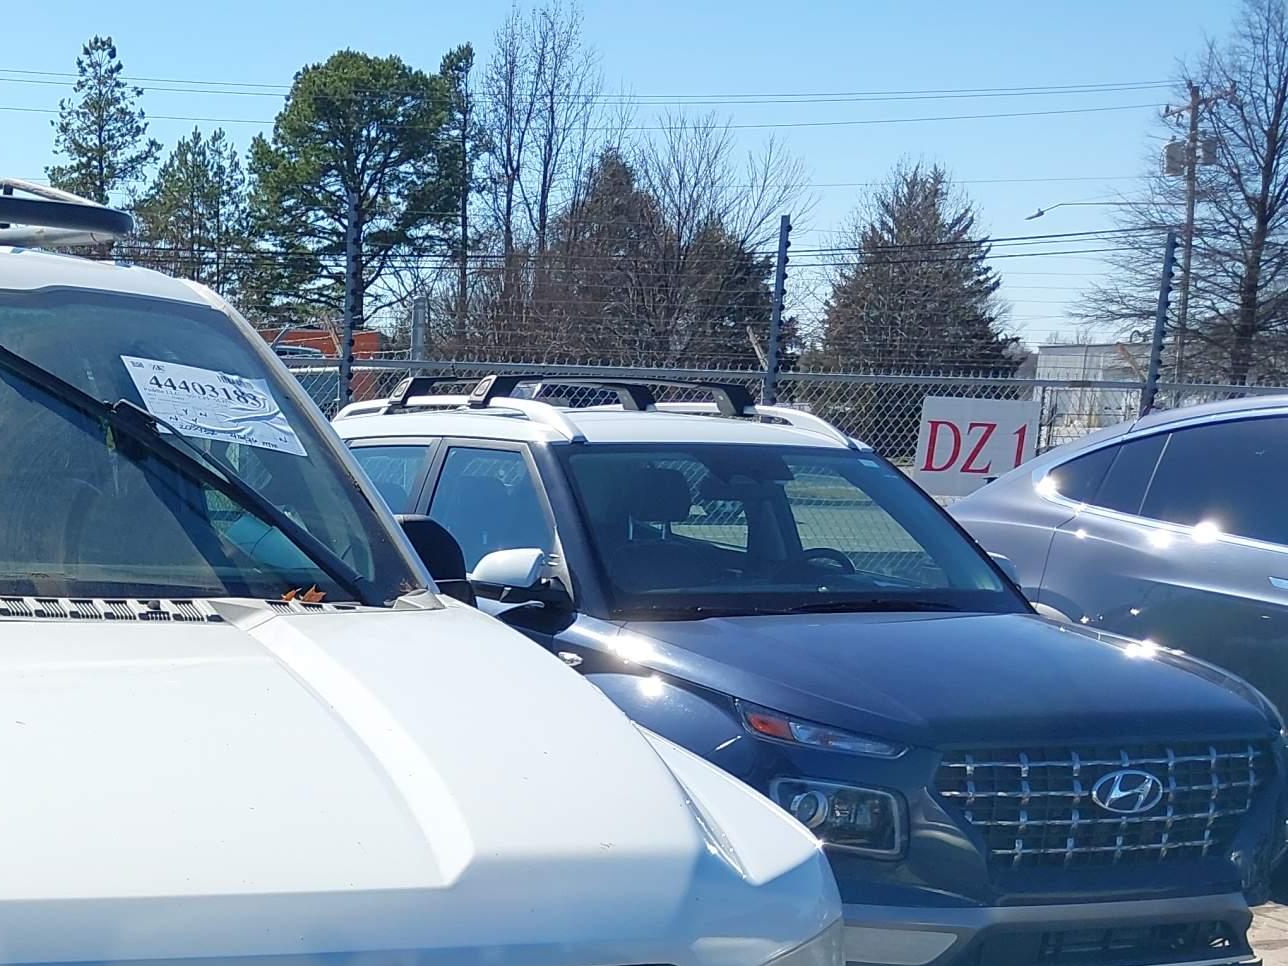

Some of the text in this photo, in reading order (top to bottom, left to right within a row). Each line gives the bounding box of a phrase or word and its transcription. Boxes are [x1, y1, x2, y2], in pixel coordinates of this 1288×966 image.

[148, 375, 262, 409] 44403183
[920, 420, 1028, 474] DZ 1
